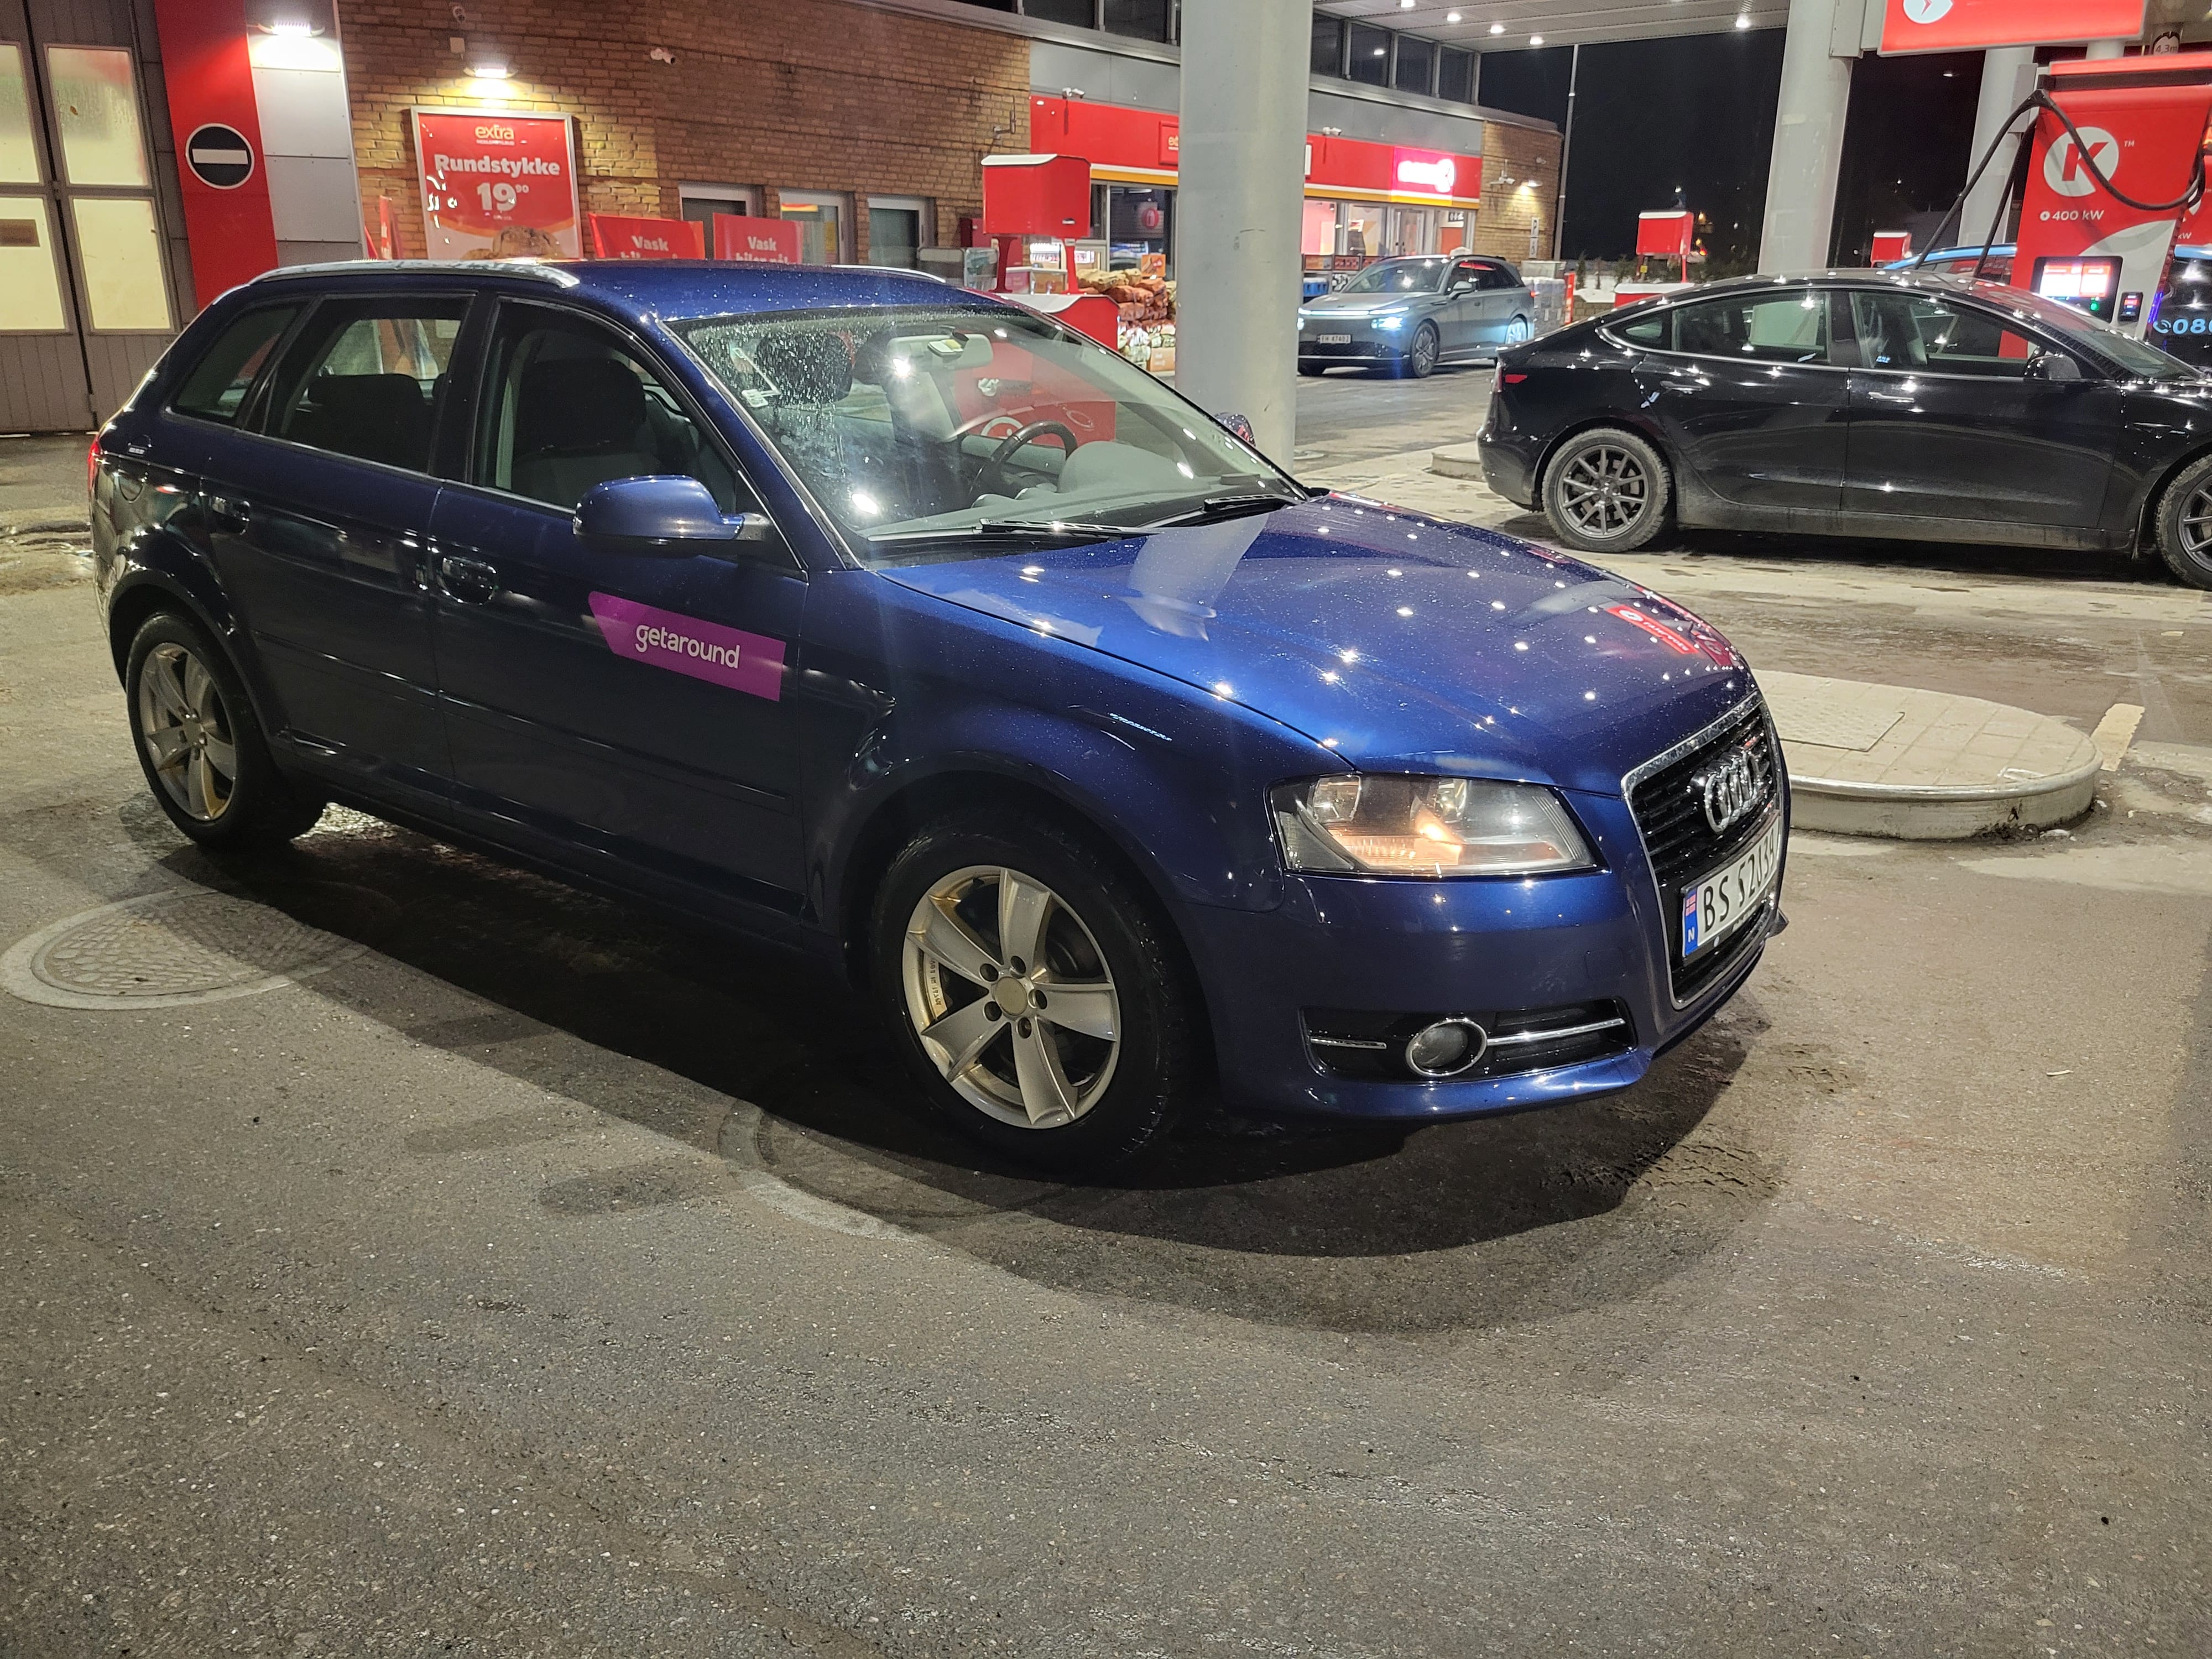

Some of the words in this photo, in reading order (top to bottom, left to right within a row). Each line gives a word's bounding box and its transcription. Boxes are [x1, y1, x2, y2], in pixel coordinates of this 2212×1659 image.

[475, 124, 514, 140] extra
[434, 154, 560, 178] Rundstykke
[477, 182, 517, 211] 19
[2052, 211, 2079, 221] 400
[2083, 210, 2104, 220] kW
[631, 235, 669, 252] Vask
[747, 236, 777, 251] Vask
[2173, 318, 2212, 335] 08
[635, 625, 740, 669] getaround
[1703, 875, 1730, 933] BS
[1688, 926, 1695, 943] N
